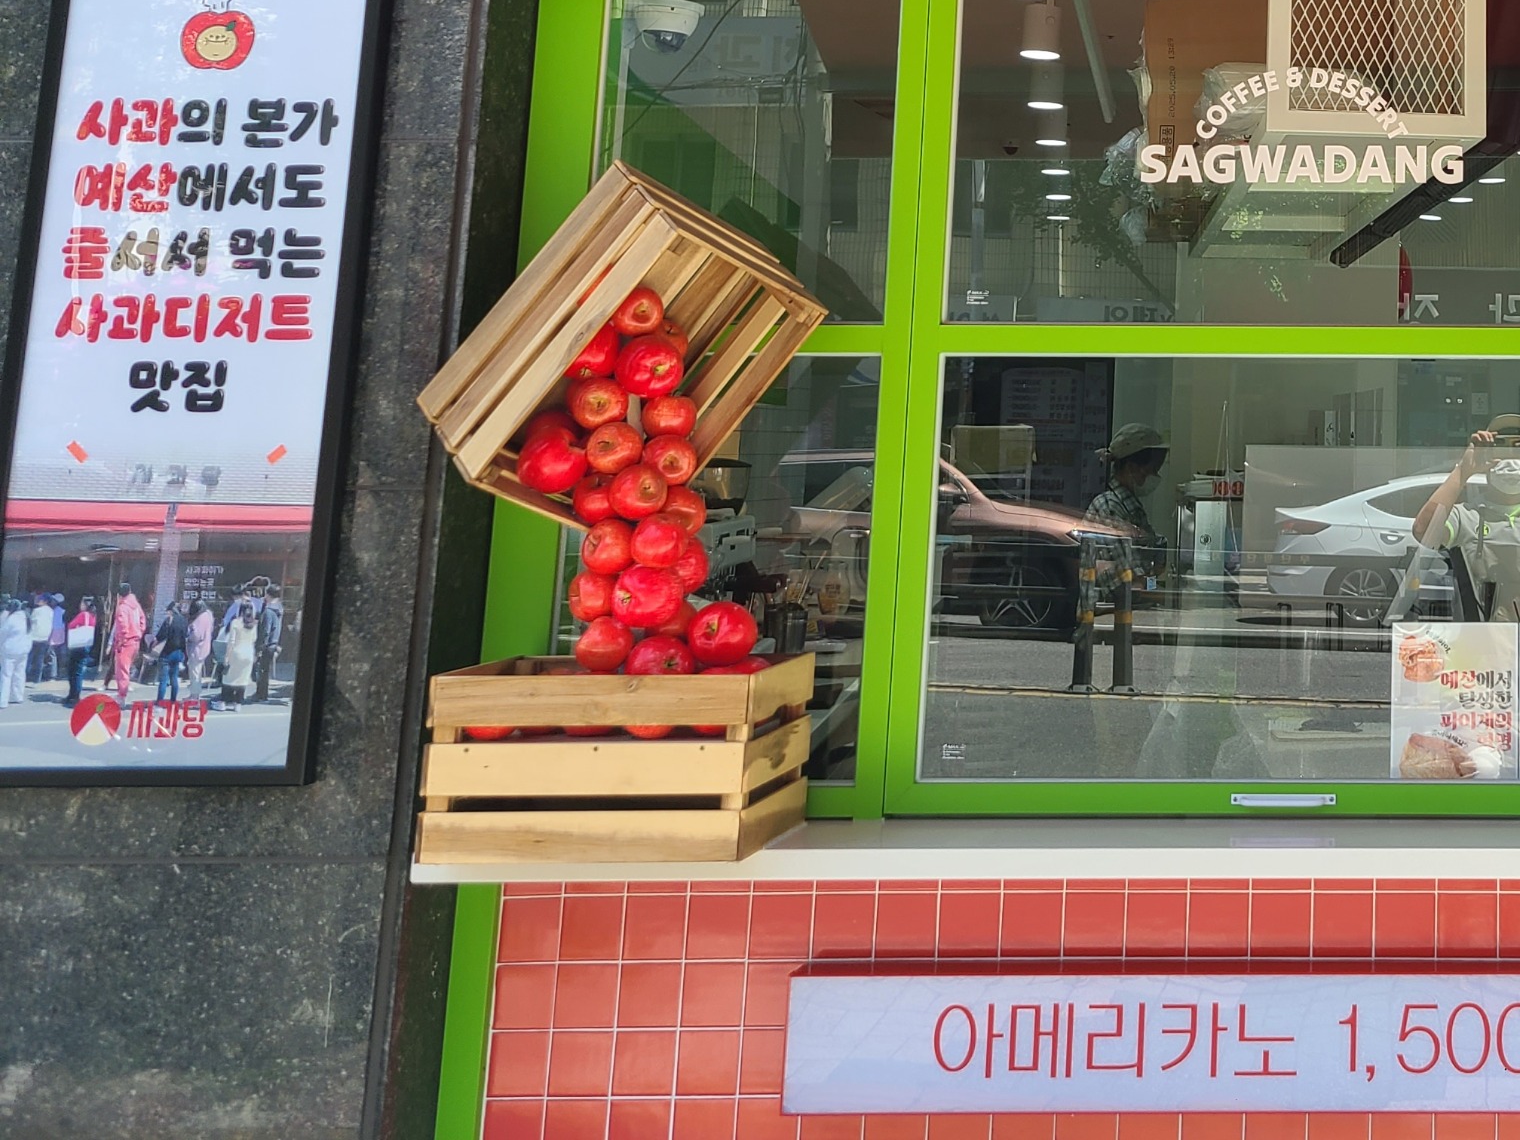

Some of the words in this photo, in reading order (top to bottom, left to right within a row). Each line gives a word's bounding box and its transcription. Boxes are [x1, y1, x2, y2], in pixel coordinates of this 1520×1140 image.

[76, 97, 227, 146] 사과의
[241, 97, 339, 149] 본가
[1195, 68, 1280, 141] COFFEE
[1286, 66, 1302, 87] &
[1309, 67, 1408, 140] DESSERT
[73, 162, 326, 213] 예산에서도
[1140, 144, 1465, 185] SAGWADANG
[62, 227, 208, 279] 줄서서
[230, 228, 326, 279] 먹는
[54, 293, 314, 343] 사과디저트
[129, 359, 228, 413] 맛집
[1440, 670, 1512, 690] 예산에서
[1459, 691, 1513, 710] 탄생한
[127, 700, 208, 738] 사과당
[932, 1001, 1297, 1078] 아메리카노
